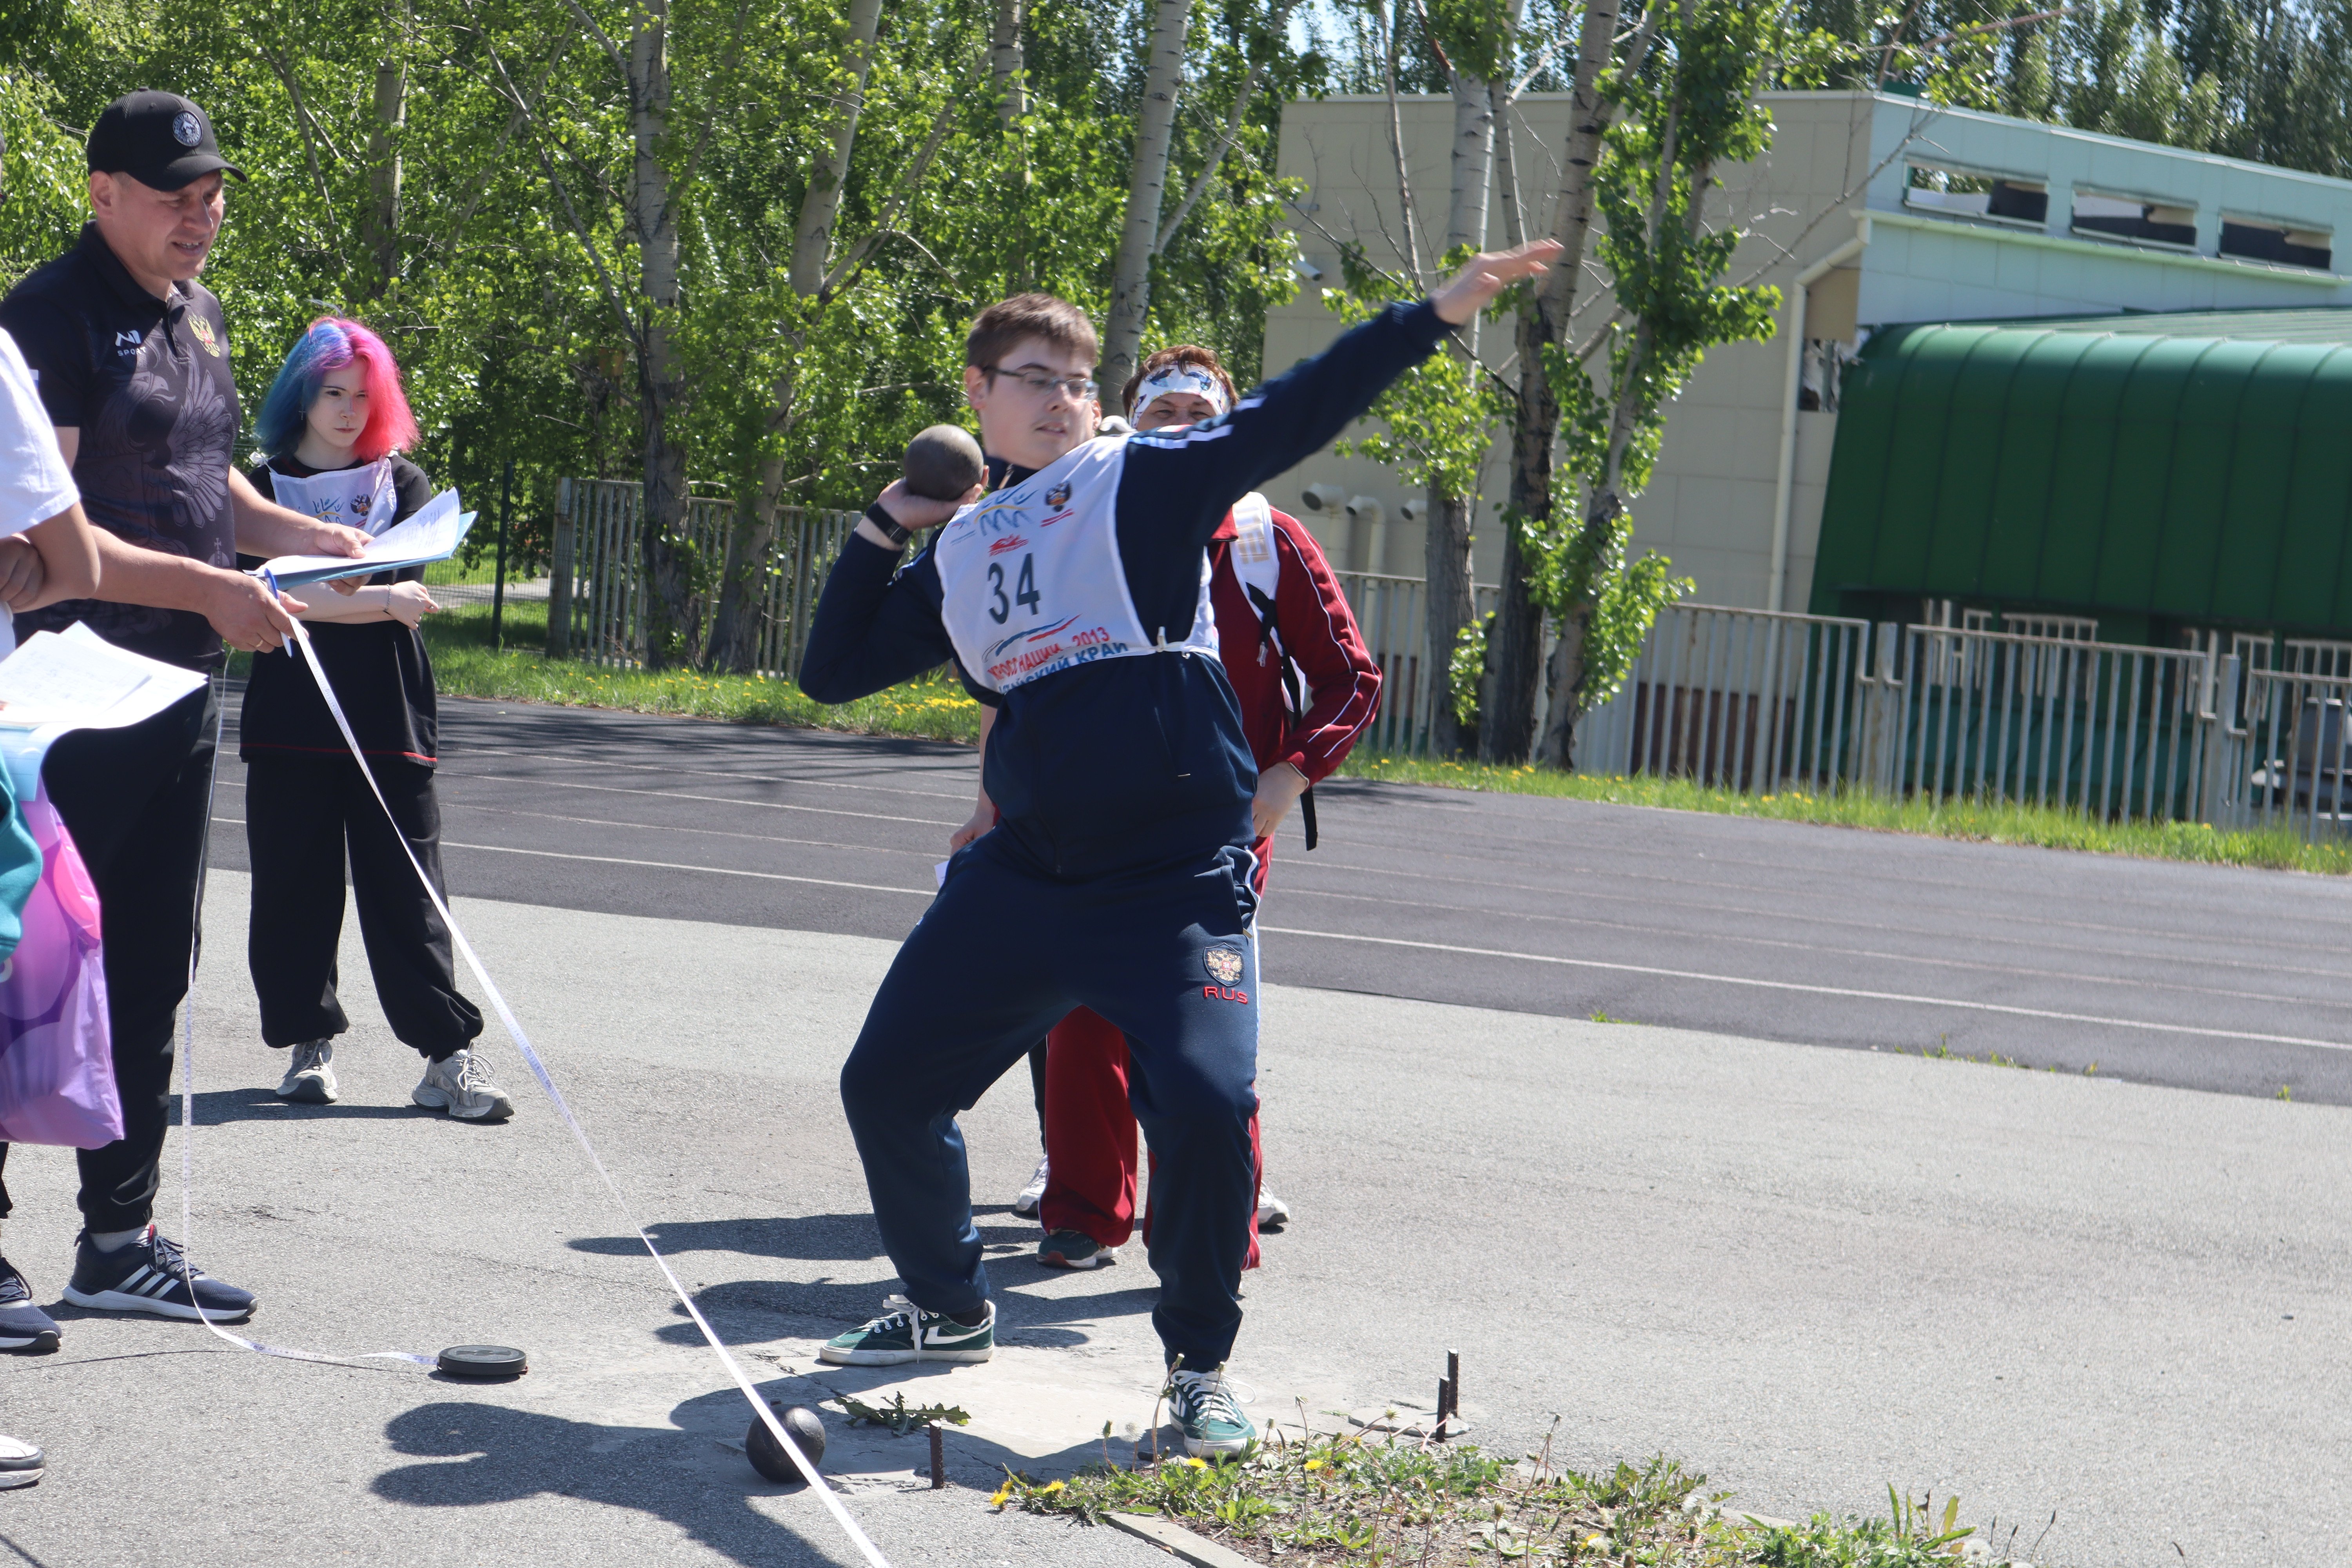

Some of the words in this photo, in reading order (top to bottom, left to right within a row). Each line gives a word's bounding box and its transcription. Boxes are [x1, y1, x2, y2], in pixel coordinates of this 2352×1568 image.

[118, 347, 146, 356] SPORT
[988, 552, 1041, 624] 34
[1072, 627, 1110, 646] 2013
[1203, 986, 1248, 1004] RUS
[183, 1109, 187, 1120] 20
